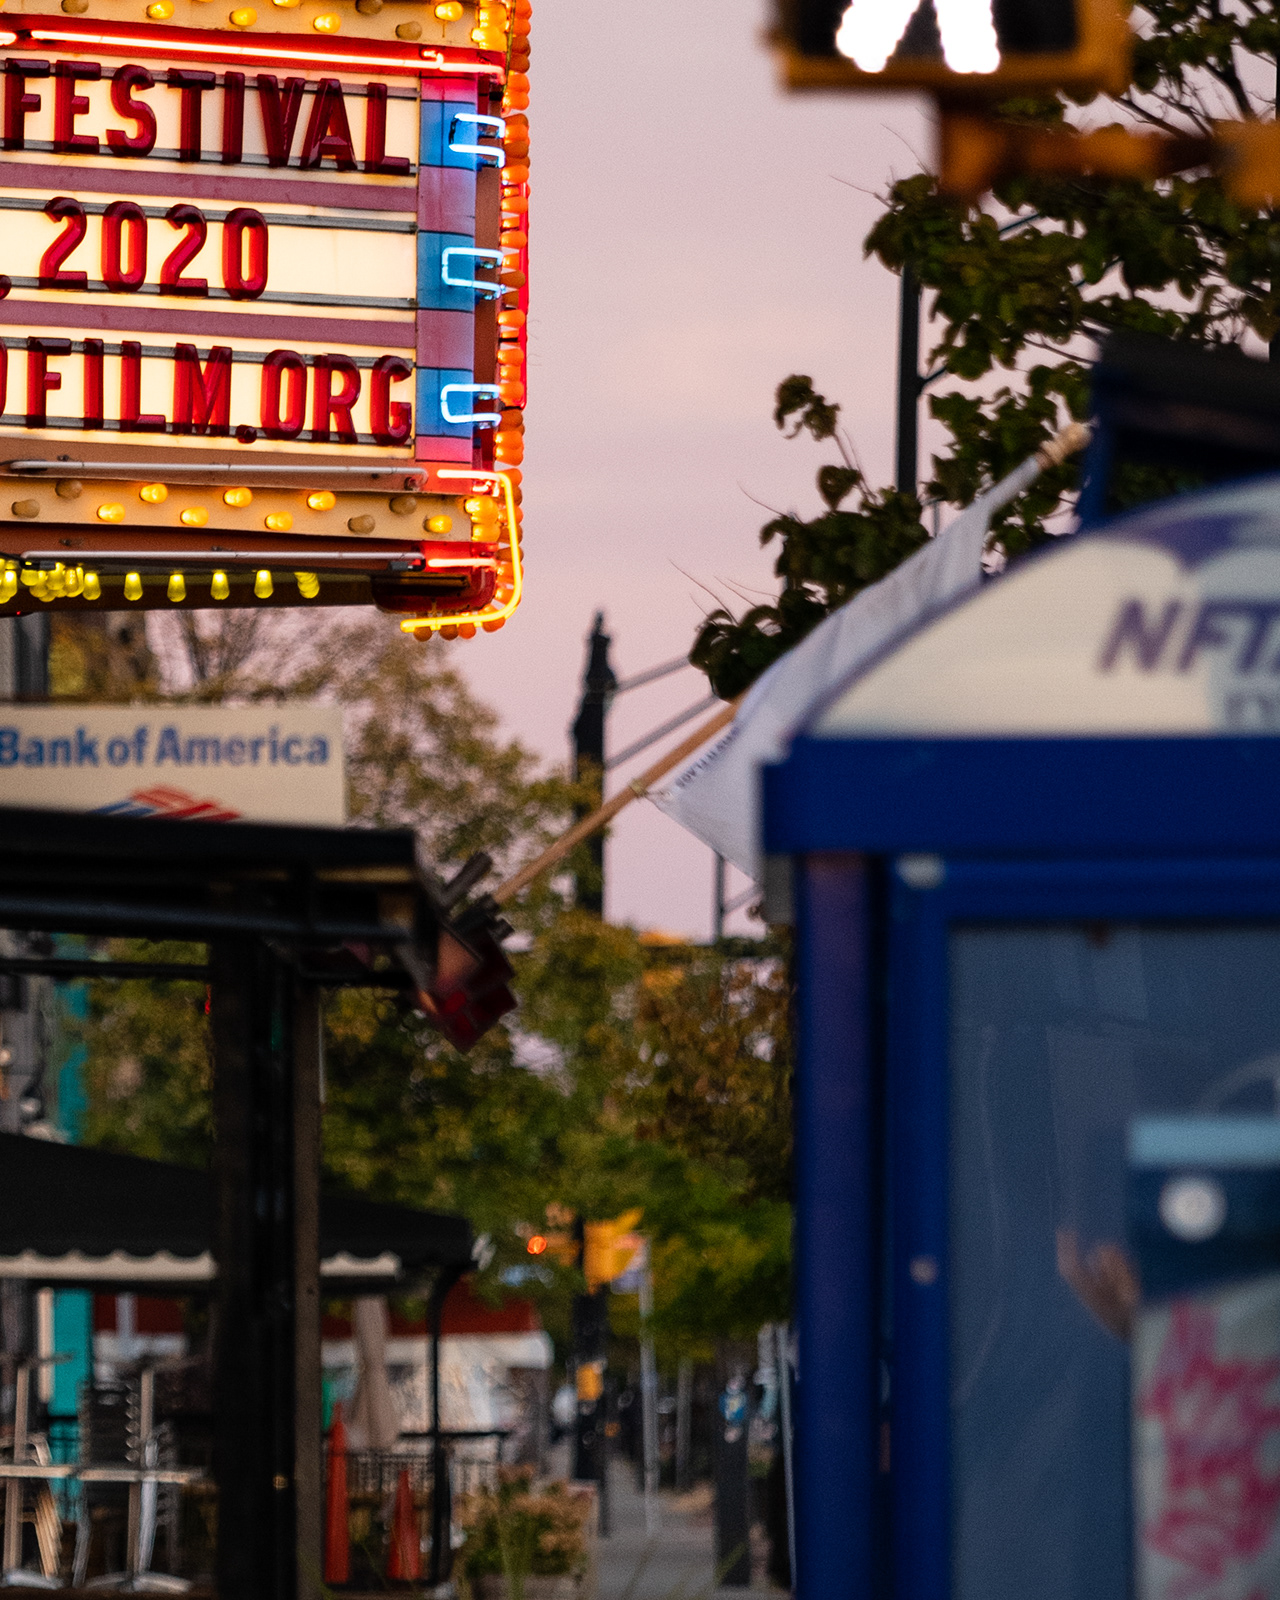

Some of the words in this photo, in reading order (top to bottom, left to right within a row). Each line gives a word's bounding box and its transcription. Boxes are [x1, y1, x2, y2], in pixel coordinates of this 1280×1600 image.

[3, 56, 411, 176] FESTIVAL
[38, 195, 270, 301] 2020
[1096, 596, 1280, 675] NFT
[105, 722, 149, 768] of
[154, 721, 330, 769] America
